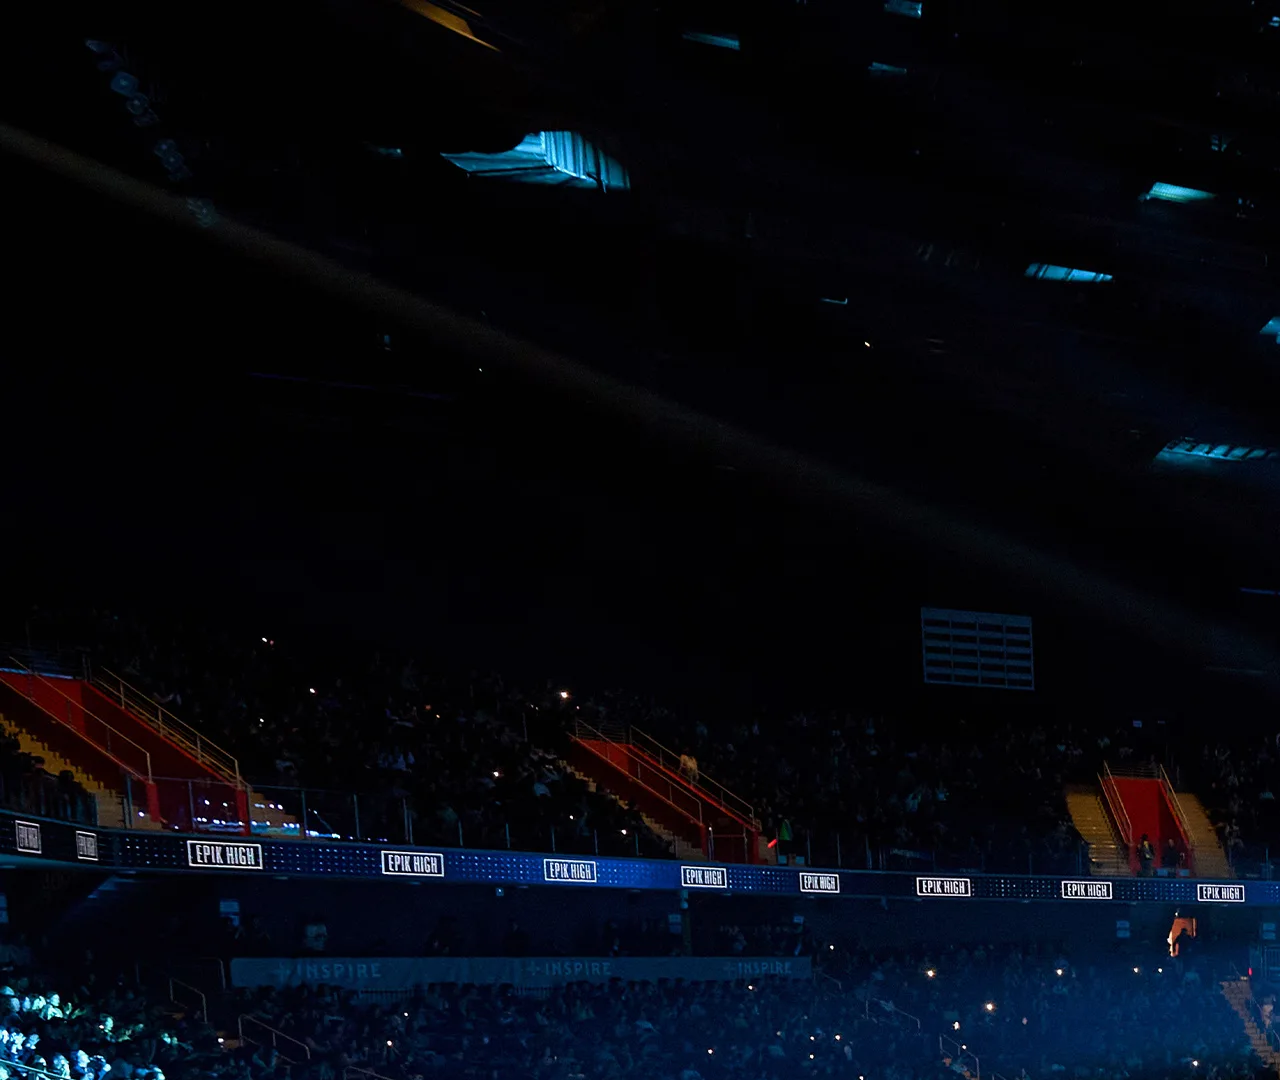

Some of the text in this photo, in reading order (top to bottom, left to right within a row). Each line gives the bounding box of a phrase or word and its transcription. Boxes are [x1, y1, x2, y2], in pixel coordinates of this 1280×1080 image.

[195, 844, 255, 866] EPIK HIGH
[388, 854, 437, 873] EPIK HIGH
[549, 862, 591, 880] EPIK HIGH
[685, 868, 722, 885] EPIK HIGH
[804, 876, 835, 890] EPIK HIGH
[922, 880, 965, 895] EPIK HIGH
[1067, 883, 1107, 898] EPIK HIGH
[1202, 887, 1240, 900] EPIK HIGH
[296, 962, 382, 979] INSPIRE
[544, 961, 612, 976] INSPIRE
[737, 961, 793, 975] INSPIRE
